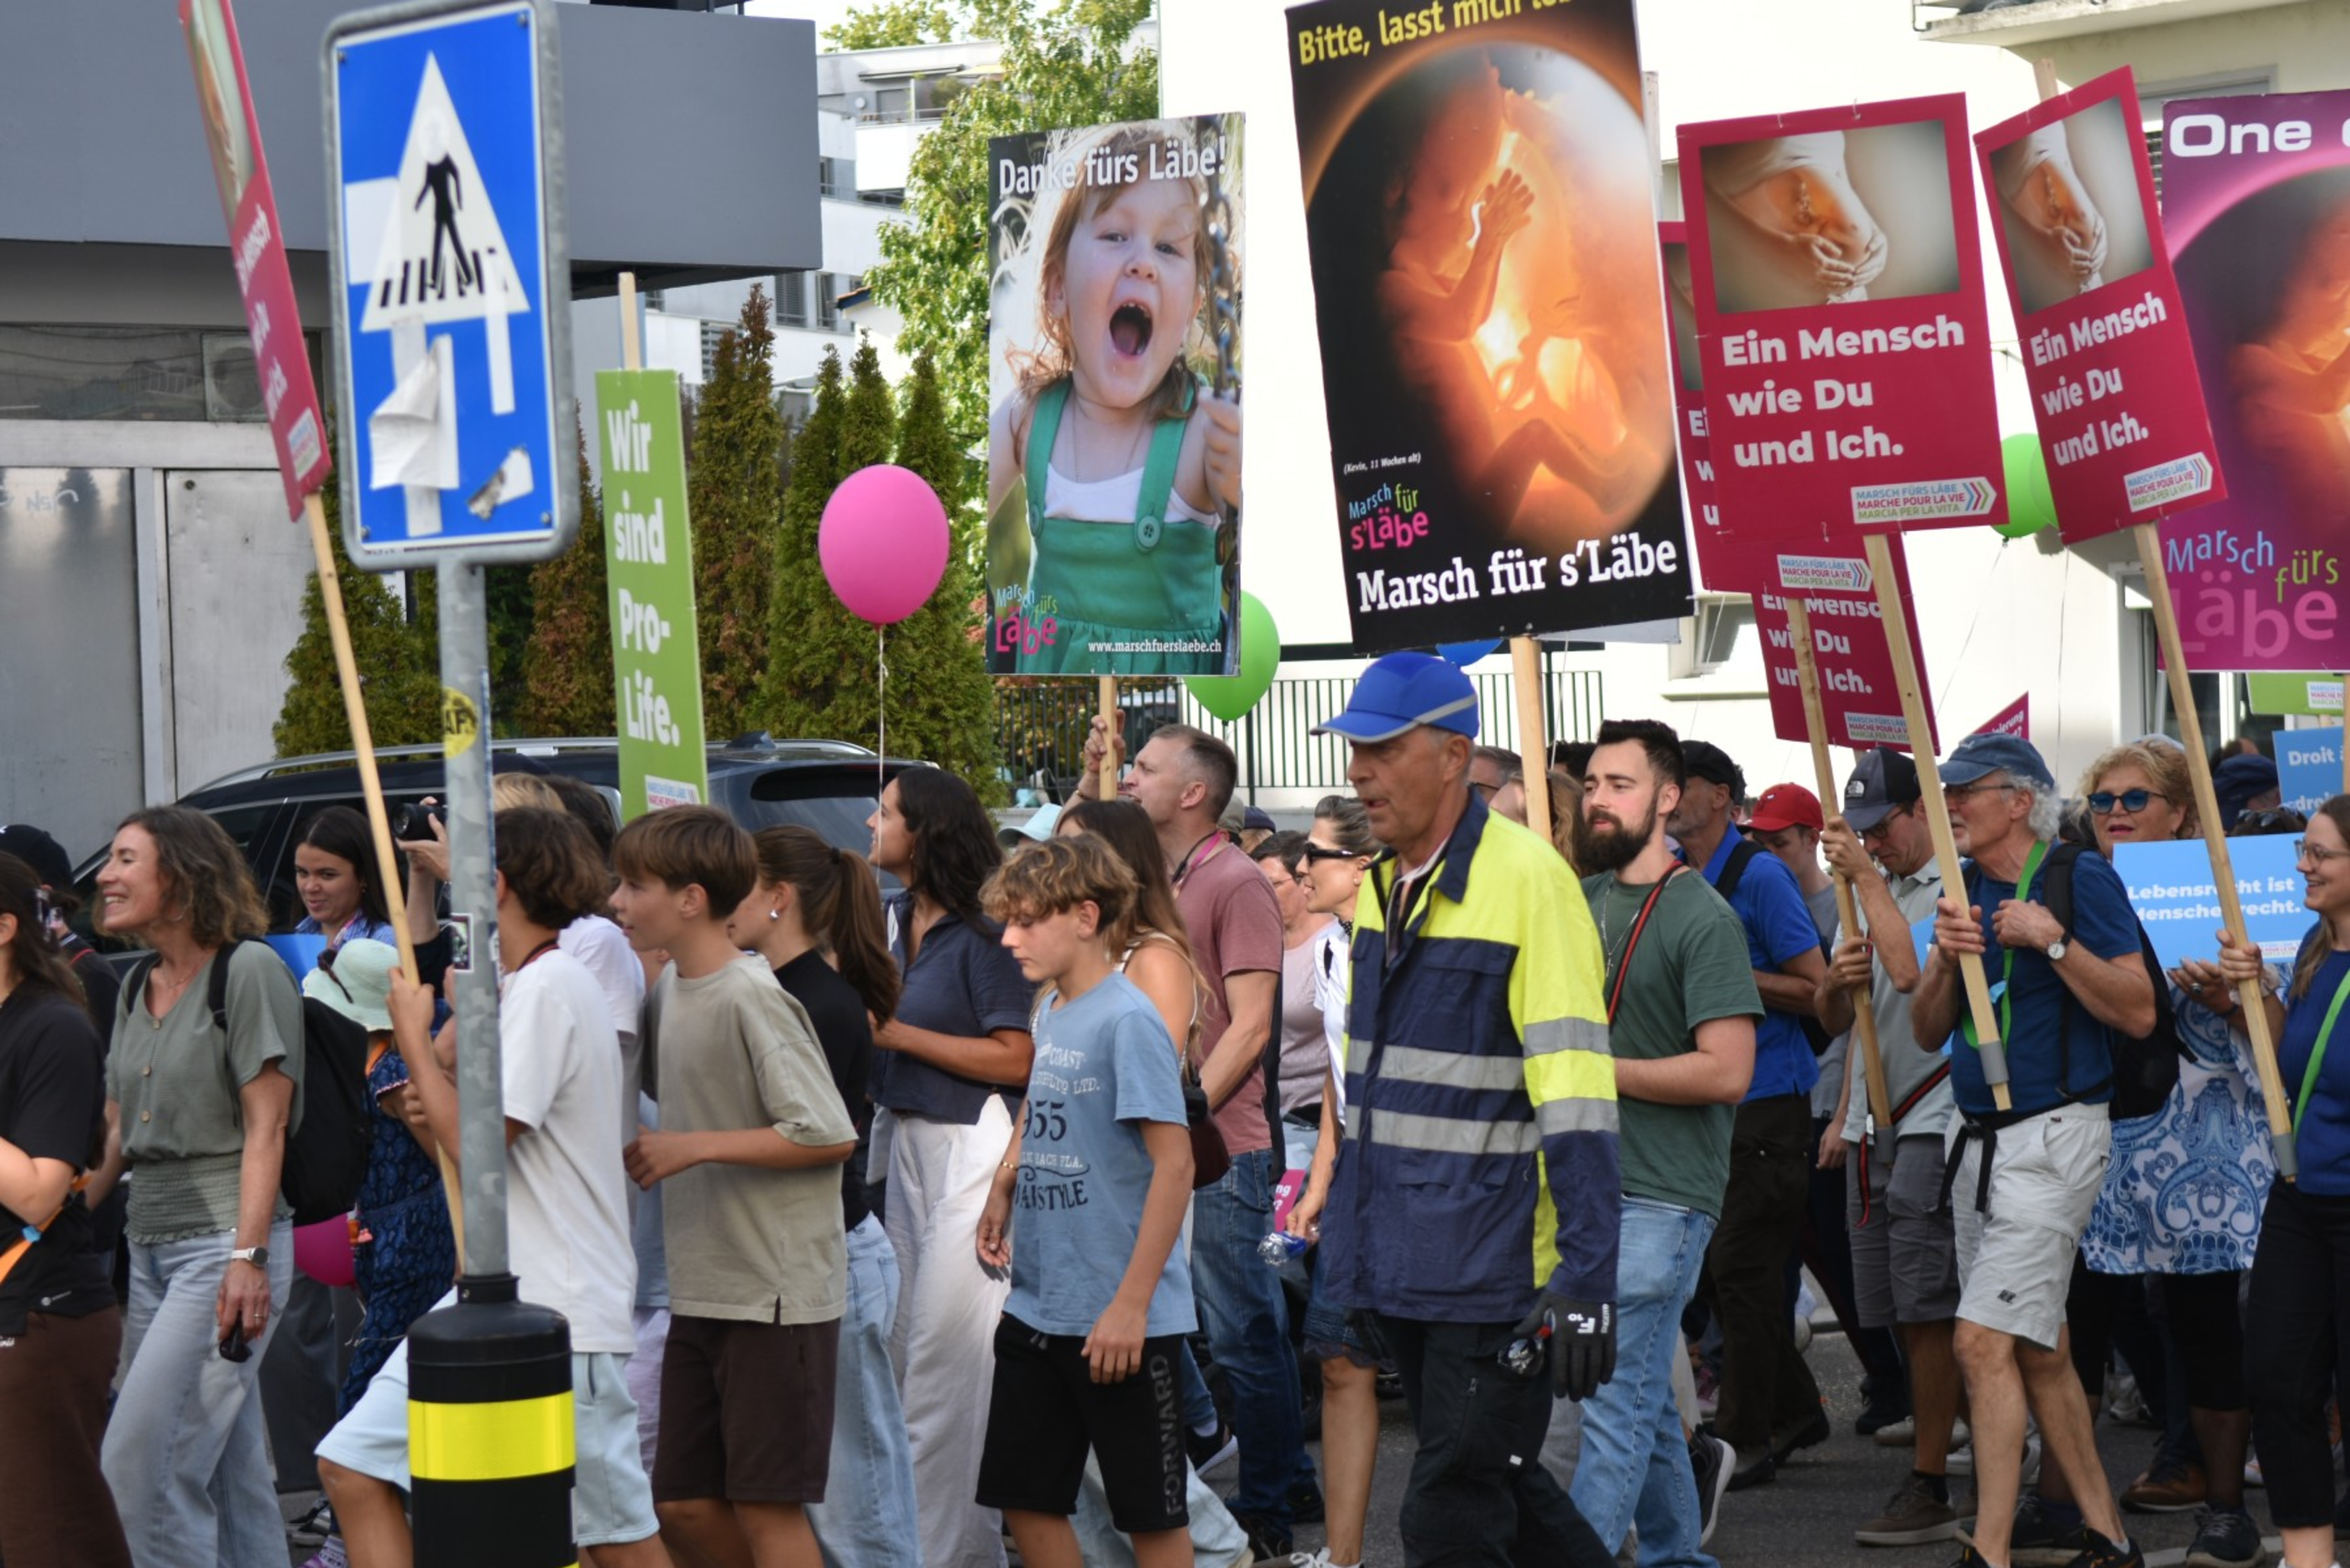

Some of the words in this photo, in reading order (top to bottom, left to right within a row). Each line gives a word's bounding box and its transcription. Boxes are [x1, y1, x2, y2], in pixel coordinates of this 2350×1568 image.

[1299, 24, 1371, 65] Bitte,
[1379, 5, 1445, 46] lasst
[2169, 114, 2311, 157] One
[999, 154, 1075, 195] Danke
[1085, 146, 1138, 186] fürs
[1150, 135, 1225, 181] Läbe!
[1722, 330, 1787, 367] Ein
[1799, 315, 1964, 360] Mensch
[2030, 328, 2068, 367] Ein
[2069, 292, 2166, 352] Mensch
[1727, 380, 1802, 417] wie
[1814, 379, 1873, 410] Du
[2042, 376, 2084, 416] wie
[2085, 367, 2123, 401] Du
[607, 398, 652, 472] Wir
[1733, 431, 1815, 468] und
[1826, 425, 1904, 461] Ich.
[2053, 427, 2099, 466] und
[2103, 411, 2149, 452] Ich.
[1370, 460, 1379, 469] 11
[1381, 455, 1406, 467] Wochen
[2130, 483, 2155, 496] MARCHE
[2157, 477, 2174, 488] POUR
[2175, 474, 2184, 483] LA
[2184, 470, 2194, 481] VIE
[1349, 482, 1392, 520] Marsch
[1395, 483, 1418, 513] für
[1856, 490, 1899, 500] MARSCH
[1902, 485, 1928, 496] FÜRS
[1931, 483, 1957, 494] LÄBE
[1857, 498, 1900, 509] MARCHE
[1903, 496, 1931, 506] POUR
[1934, 495, 1946, 504] LA
[1949, 493, 1965, 502] VIE
[1858, 509, 1897, 519] MARCIA
[1900, 506, 1920, 516] PER
[1922, 506, 1934, 515] LA
[1936, 504, 1959, 513] VITA
[614, 491, 667, 564] sind
[1357, 556, 1479, 613] Marsch
[1488, 548, 1548, 596] für
[2168, 530, 2274, 573] Marsch
[2275, 550, 2339, 603] fürs
[618, 588, 671, 654] Pro-
[997, 583, 1035, 608] Marsch
[1034, 594, 1057, 624] fürs
[1804, 597, 1882, 618] Mensc
[996, 607, 1058, 654] Läbe
[1089, 639, 1222, 652] www.marschfuerslaebe.ch
[1767, 623, 1795, 649] wi
[1815, 629, 1851, 654] Du
[1775, 666, 1799, 687] un
[1825, 668, 1872, 693] Ich.
[624, 669, 680, 747] Life.
[2288, 746, 2335, 766] Droit
[2267, 877, 2294, 892] ist
[1073, 1077, 1100, 1094] LTD.
[1577, 1317, 1595, 1334] F
[1150, 1354, 1183, 1516] FORWARD
